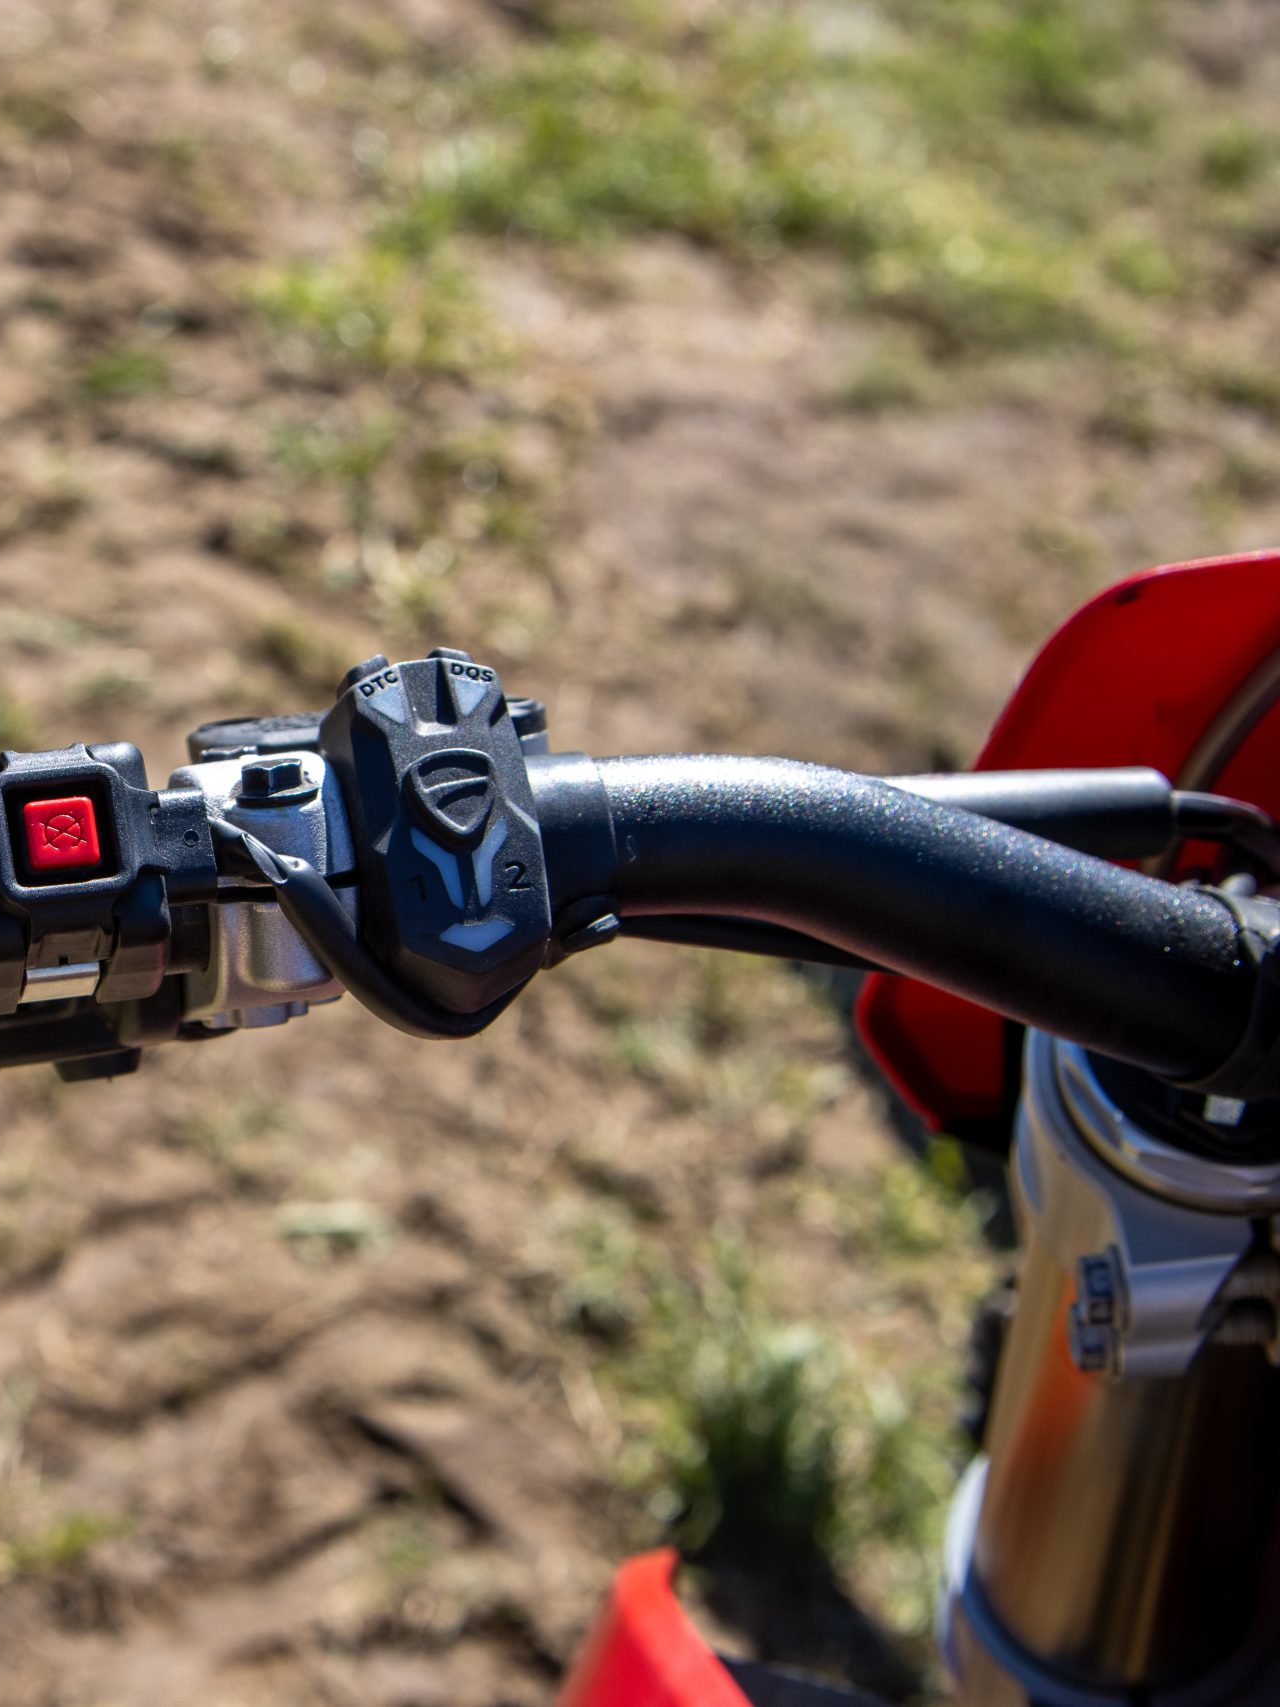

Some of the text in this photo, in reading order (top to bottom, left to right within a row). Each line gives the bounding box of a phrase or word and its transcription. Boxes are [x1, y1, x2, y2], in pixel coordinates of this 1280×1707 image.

[358, 669, 399, 698] DTC
[449, 662, 495, 684] DQS
[409, 873, 427, 901] 1
[503, 860, 531, 893] 2
